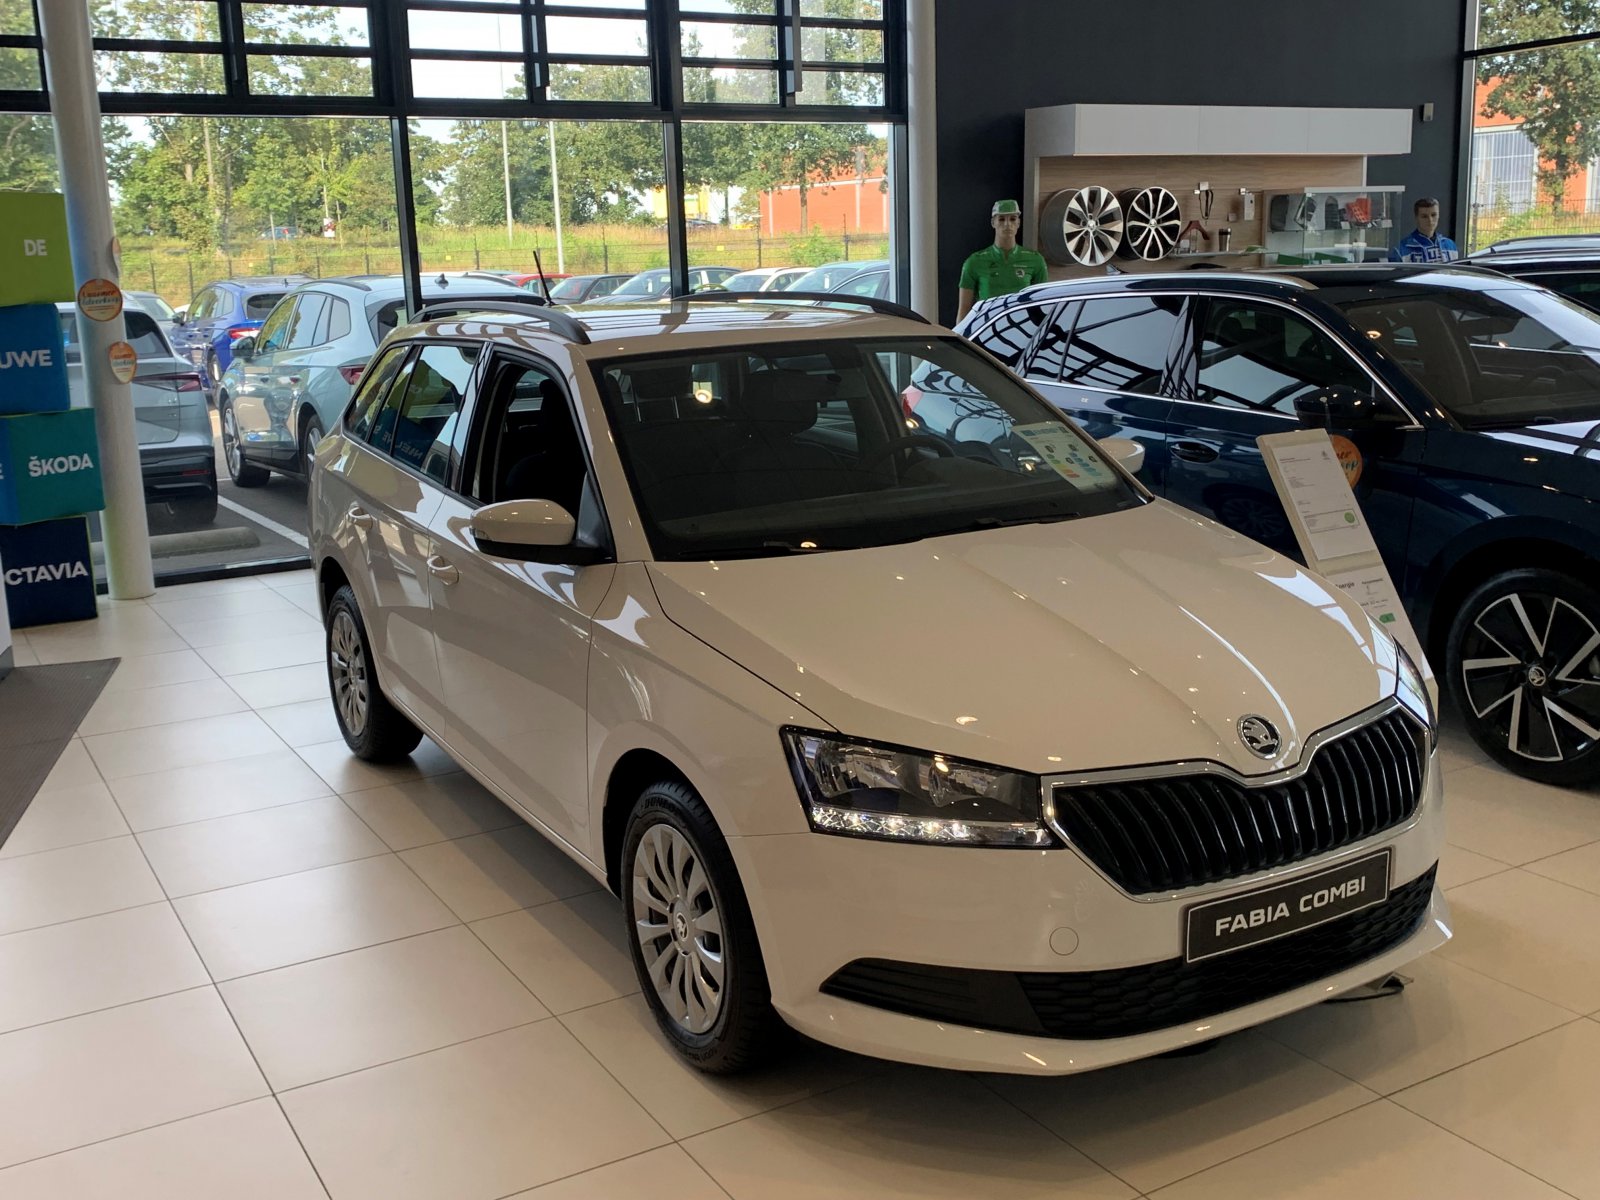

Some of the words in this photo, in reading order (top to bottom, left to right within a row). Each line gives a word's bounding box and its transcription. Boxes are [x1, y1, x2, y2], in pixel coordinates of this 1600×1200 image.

[24, 239, 48, 256] DE
[28, 453, 94, 478] ŠKODA
[1215, 902, 1290, 936] FABIA
[1299, 876, 1366, 913] COMBI
